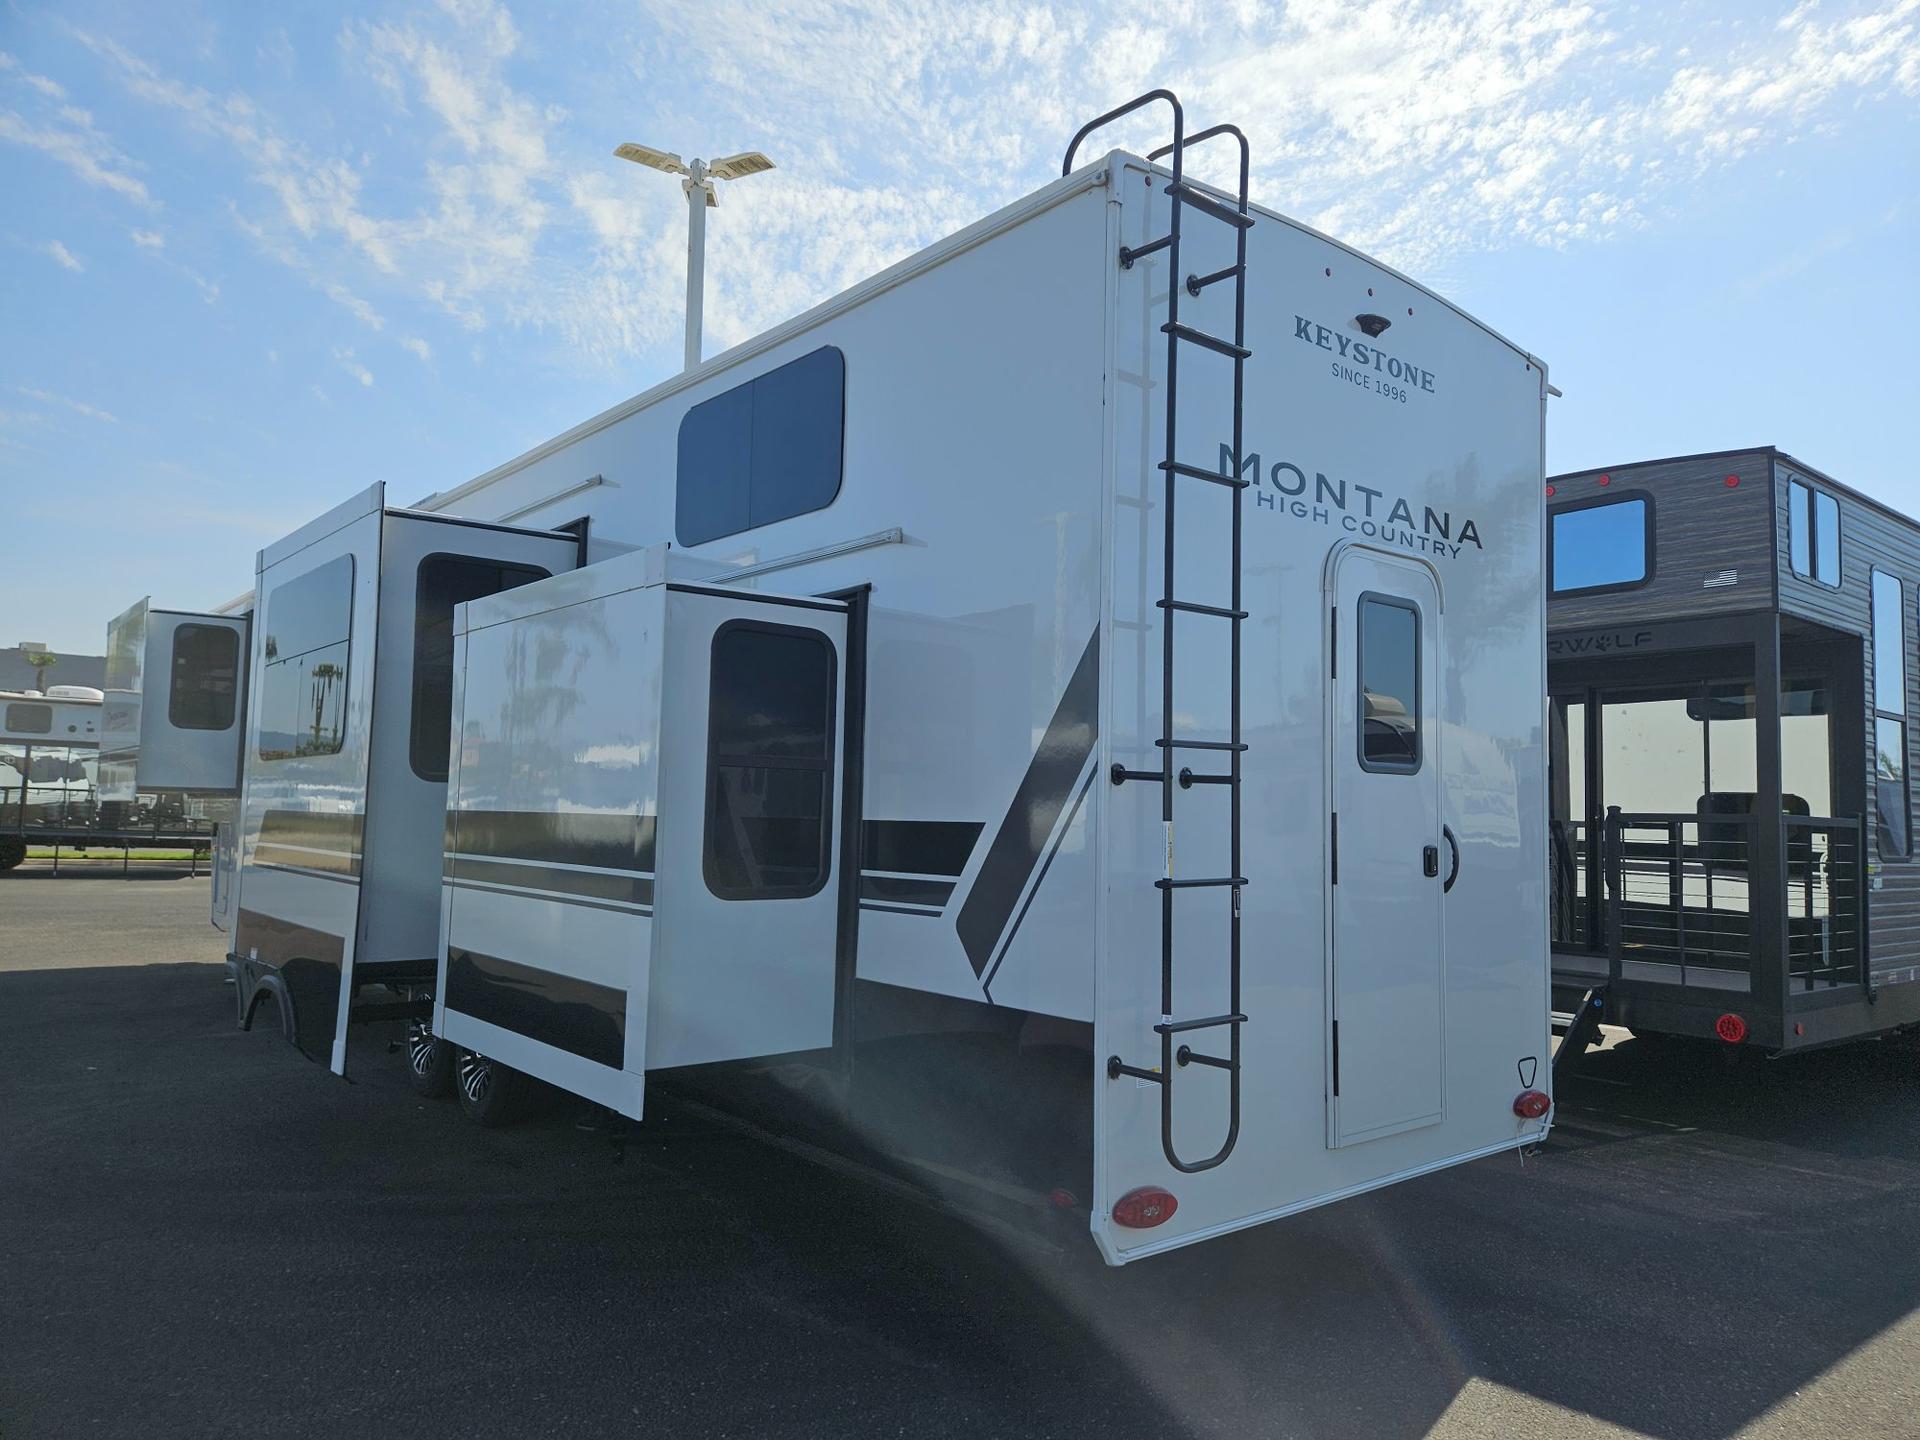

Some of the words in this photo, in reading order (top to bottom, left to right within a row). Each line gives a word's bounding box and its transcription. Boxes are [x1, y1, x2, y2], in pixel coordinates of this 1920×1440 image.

[1294, 315, 1435, 393] KEYSTONE
[1331, 362, 1370, 389] SINCE
[1376, 380, 1407, 403] 1996
[1220, 442, 1483, 549] MONTANA
[1257, 490, 1329, 525] HIGH
[1342, 515, 1461, 559] COUNTRY
